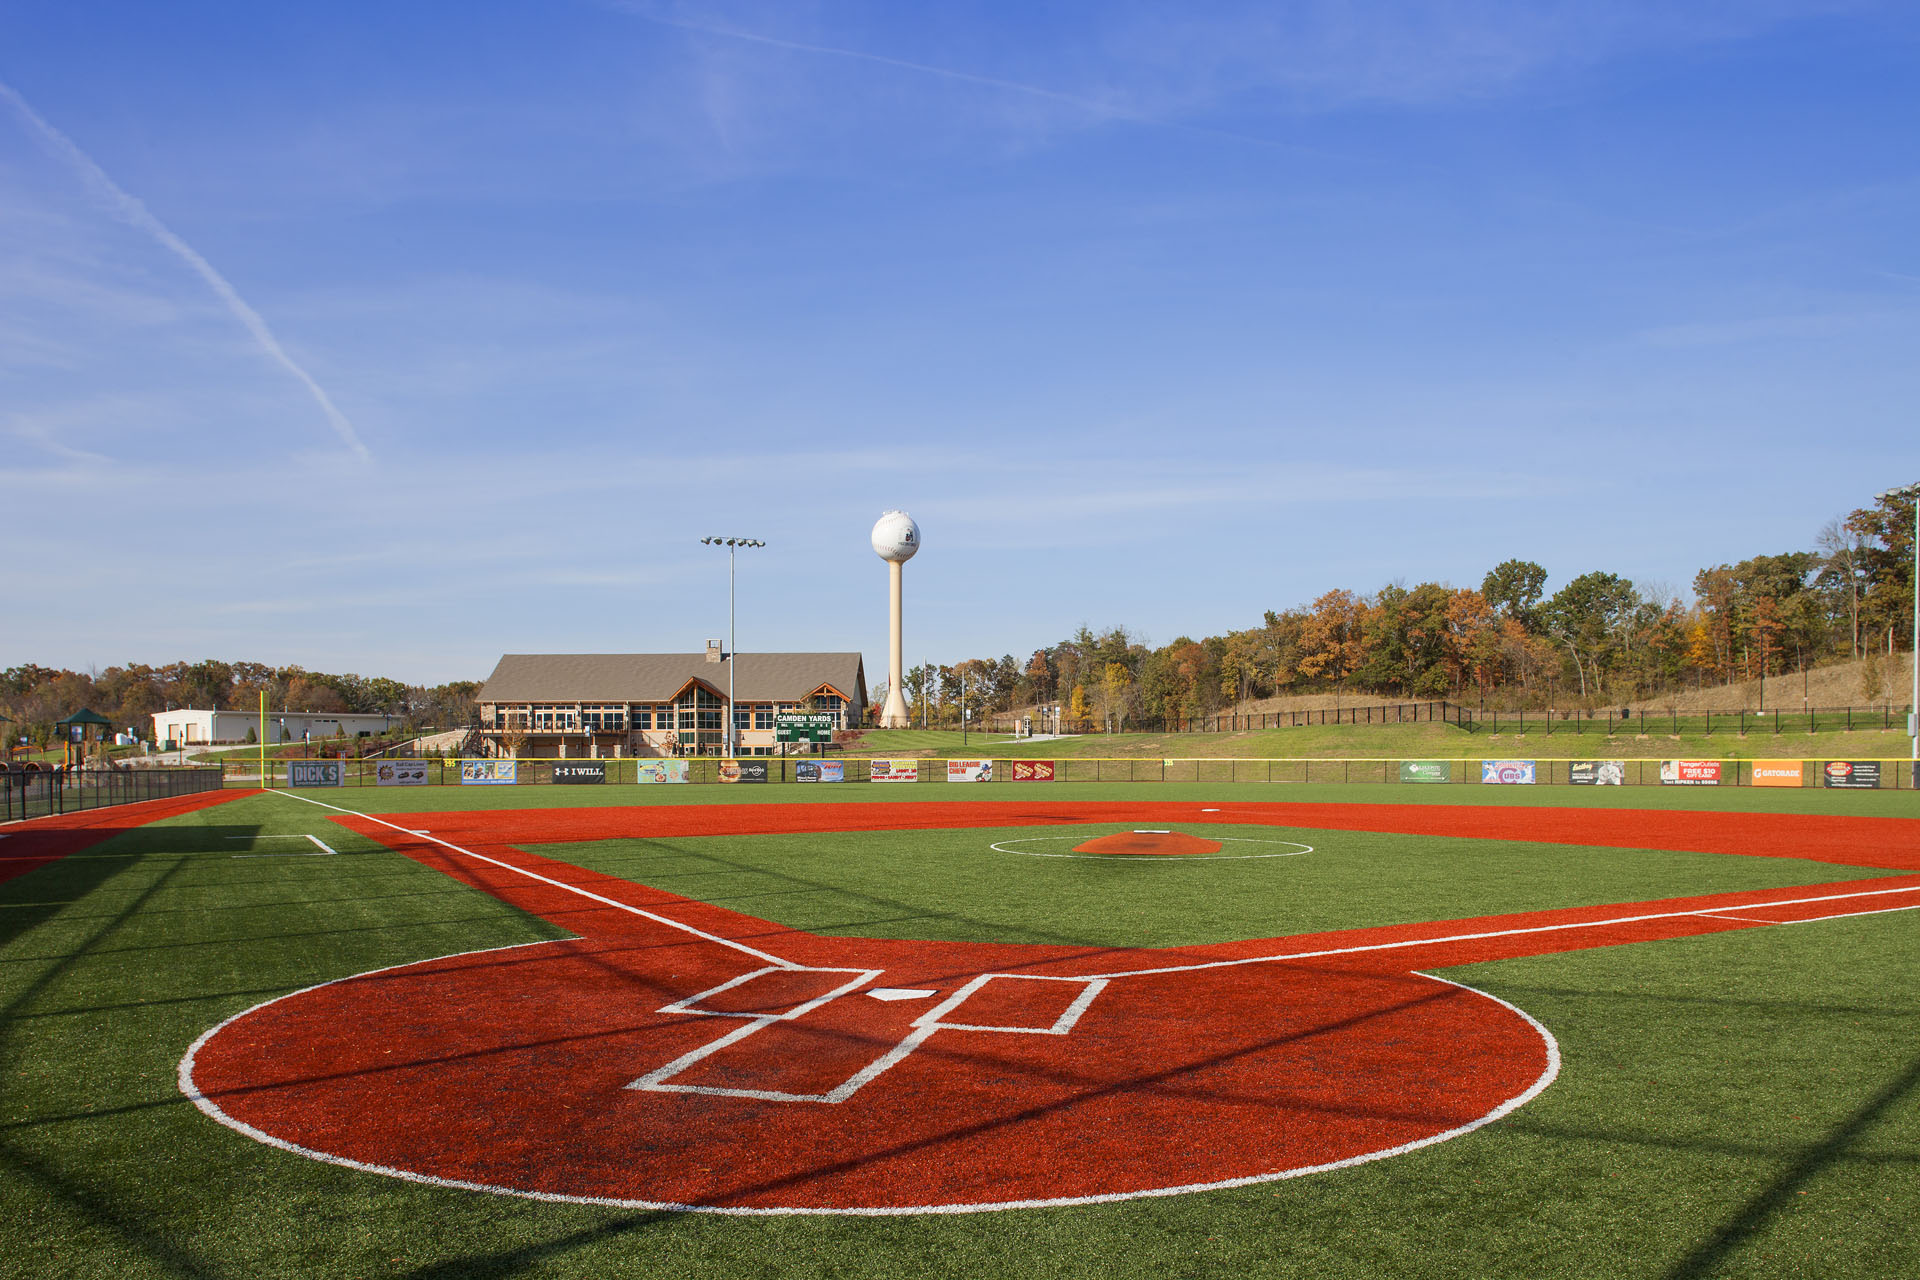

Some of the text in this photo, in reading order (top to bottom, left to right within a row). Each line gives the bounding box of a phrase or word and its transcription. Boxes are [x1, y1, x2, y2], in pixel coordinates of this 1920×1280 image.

[294, 766, 337, 781] DICK'S
[571, 767, 576, 776] I
[1762, 769, 1800, 777] GATORADE
